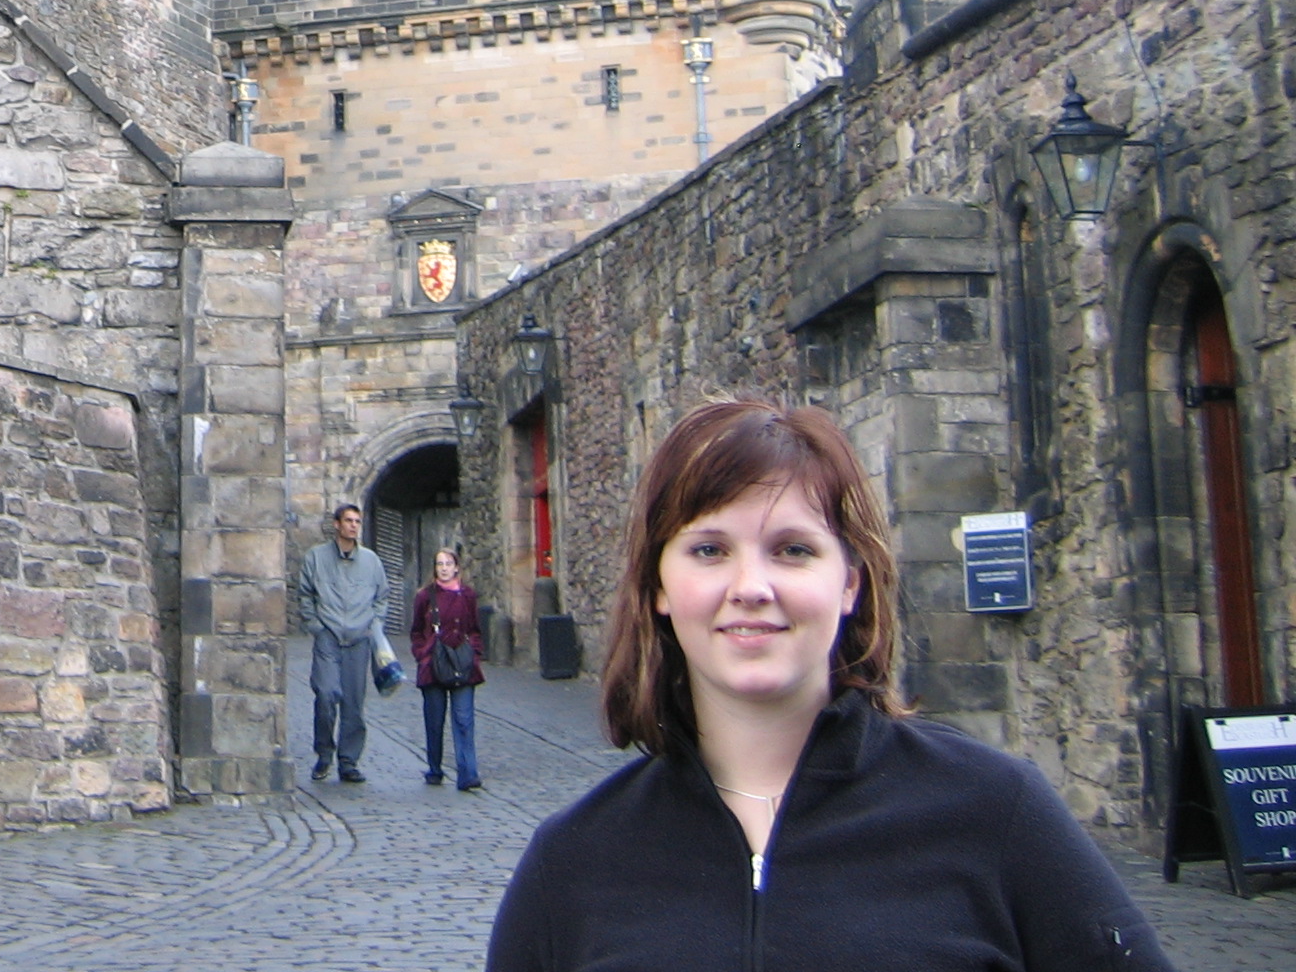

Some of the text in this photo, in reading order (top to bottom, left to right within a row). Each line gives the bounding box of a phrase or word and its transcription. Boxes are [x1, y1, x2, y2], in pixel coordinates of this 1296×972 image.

[1223, 765, 1296, 784] SOUVENI
[1252, 788, 1289, 805] GIFT
[1255, 810, 1296, 828] SHOP
